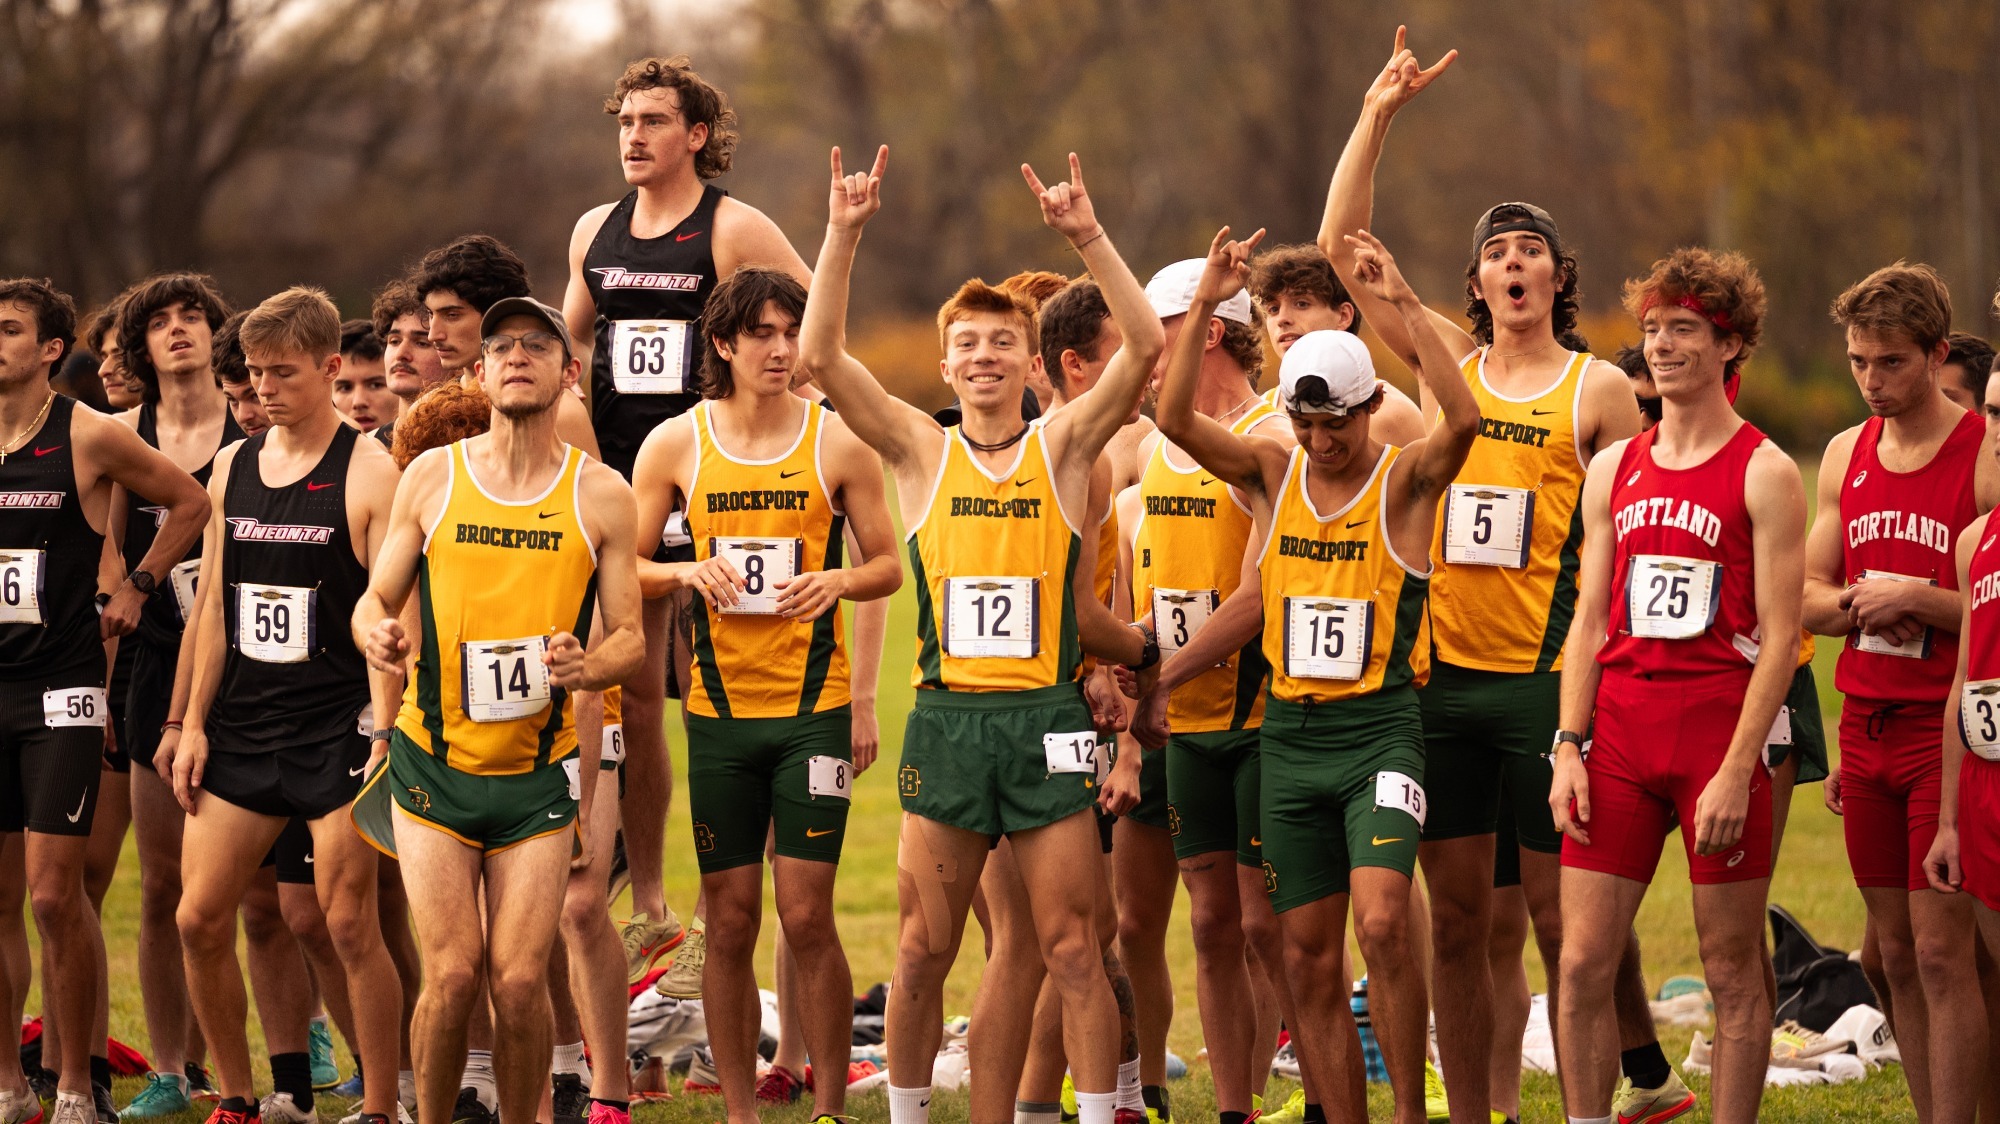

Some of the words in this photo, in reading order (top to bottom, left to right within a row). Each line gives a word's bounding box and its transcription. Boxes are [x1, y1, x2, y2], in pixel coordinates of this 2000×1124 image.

[596, 267, 702, 291] ONEONTA
[629, 337, 665, 375] 63
[707, 490, 809, 513] BROCKPORT
[951, 497, 1041, 518] BROCKPORT
[1146, 496, 1216, 518] BROCKPORT
[229, 518, 333, 544] ONEONTA
[456, 524, 562, 551] BROCKPORT
[1473, 504, 1492, 545] 5
[1615, 497, 1722, 547] CORTLAND
[1848, 510, 1949, 554] CORTLAND
[1279, 535, 1368, 562] BROCKPORT
[0, 567, 20, 606] 6
[745, 555, 764, 595] 8
[971, 595, 1011, 637] 12
[1647, 575, 1690, 619] 25
[255, 603, 290, 643] 59
[1172, 608, 1189, 648] 3
[1309, 616, 1345, 658] 15
[488, 657, 530, 700] 14
[67, 694, 94, 718] 56
[1976, 700, 2000, 742] 3
[1069, 739, 1094, 764] 12
[836, 765, 844, 789] 8
[1402, 783, 1421, 814] 15
[936, 863, 944, 874] KT
